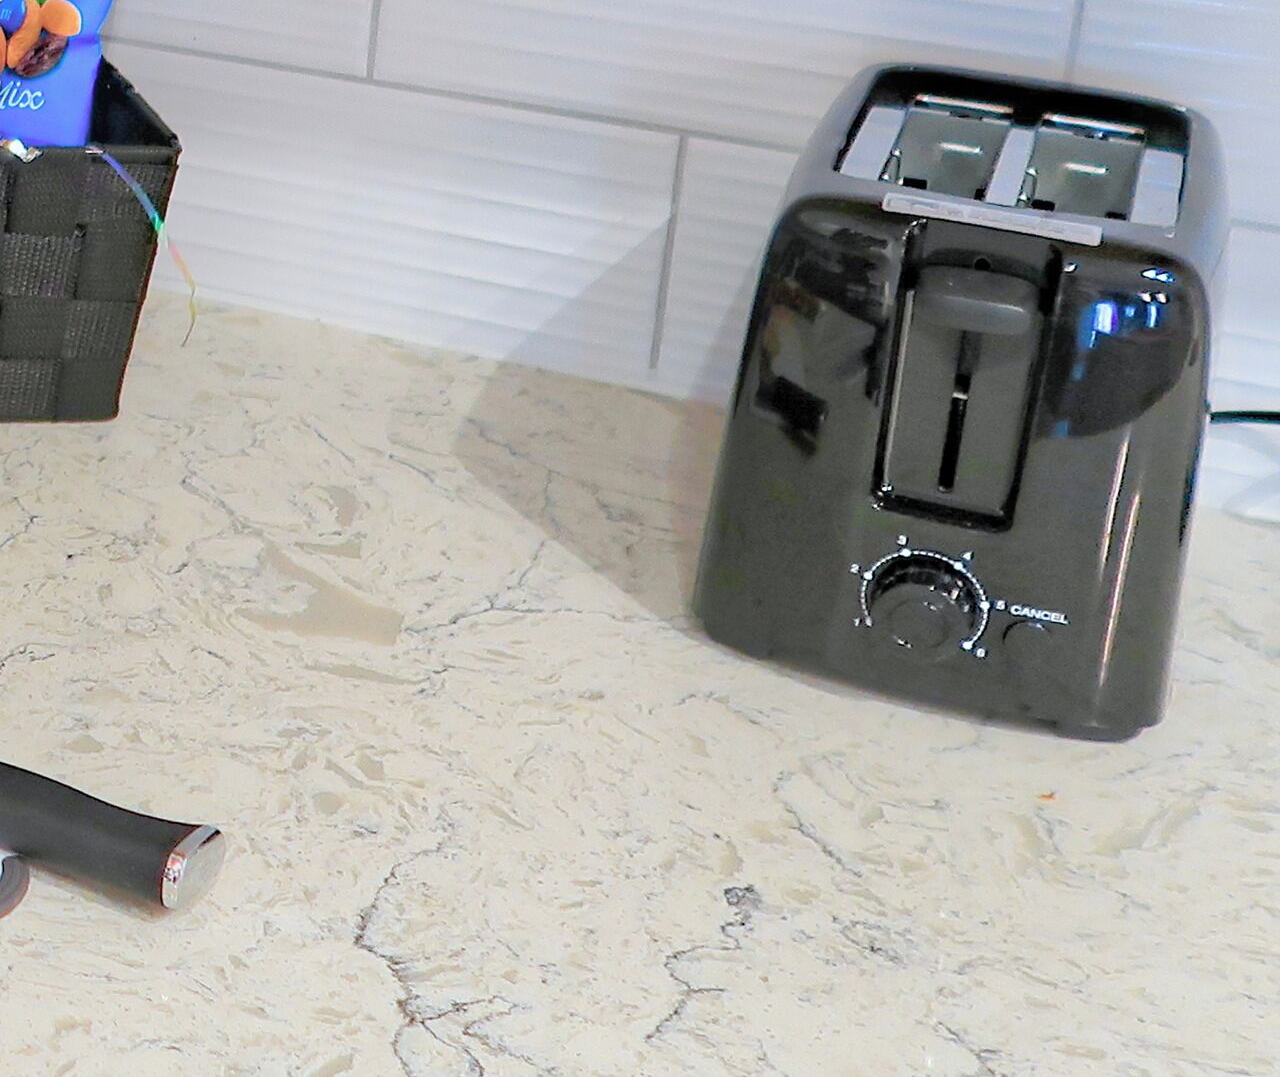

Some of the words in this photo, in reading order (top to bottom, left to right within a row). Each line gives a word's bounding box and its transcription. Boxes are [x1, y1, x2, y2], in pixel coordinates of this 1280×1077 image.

[896, 534, 908, 546] 3
[962, 550, 975, 561] 4
[849, 563, 861, 574] 2
[995, 599, 1006, 611] 5
[1009, 604, 1070, 625] CANCEL
[853, 617, 861, 627] 1
[976, 647, 987, 659] 6
